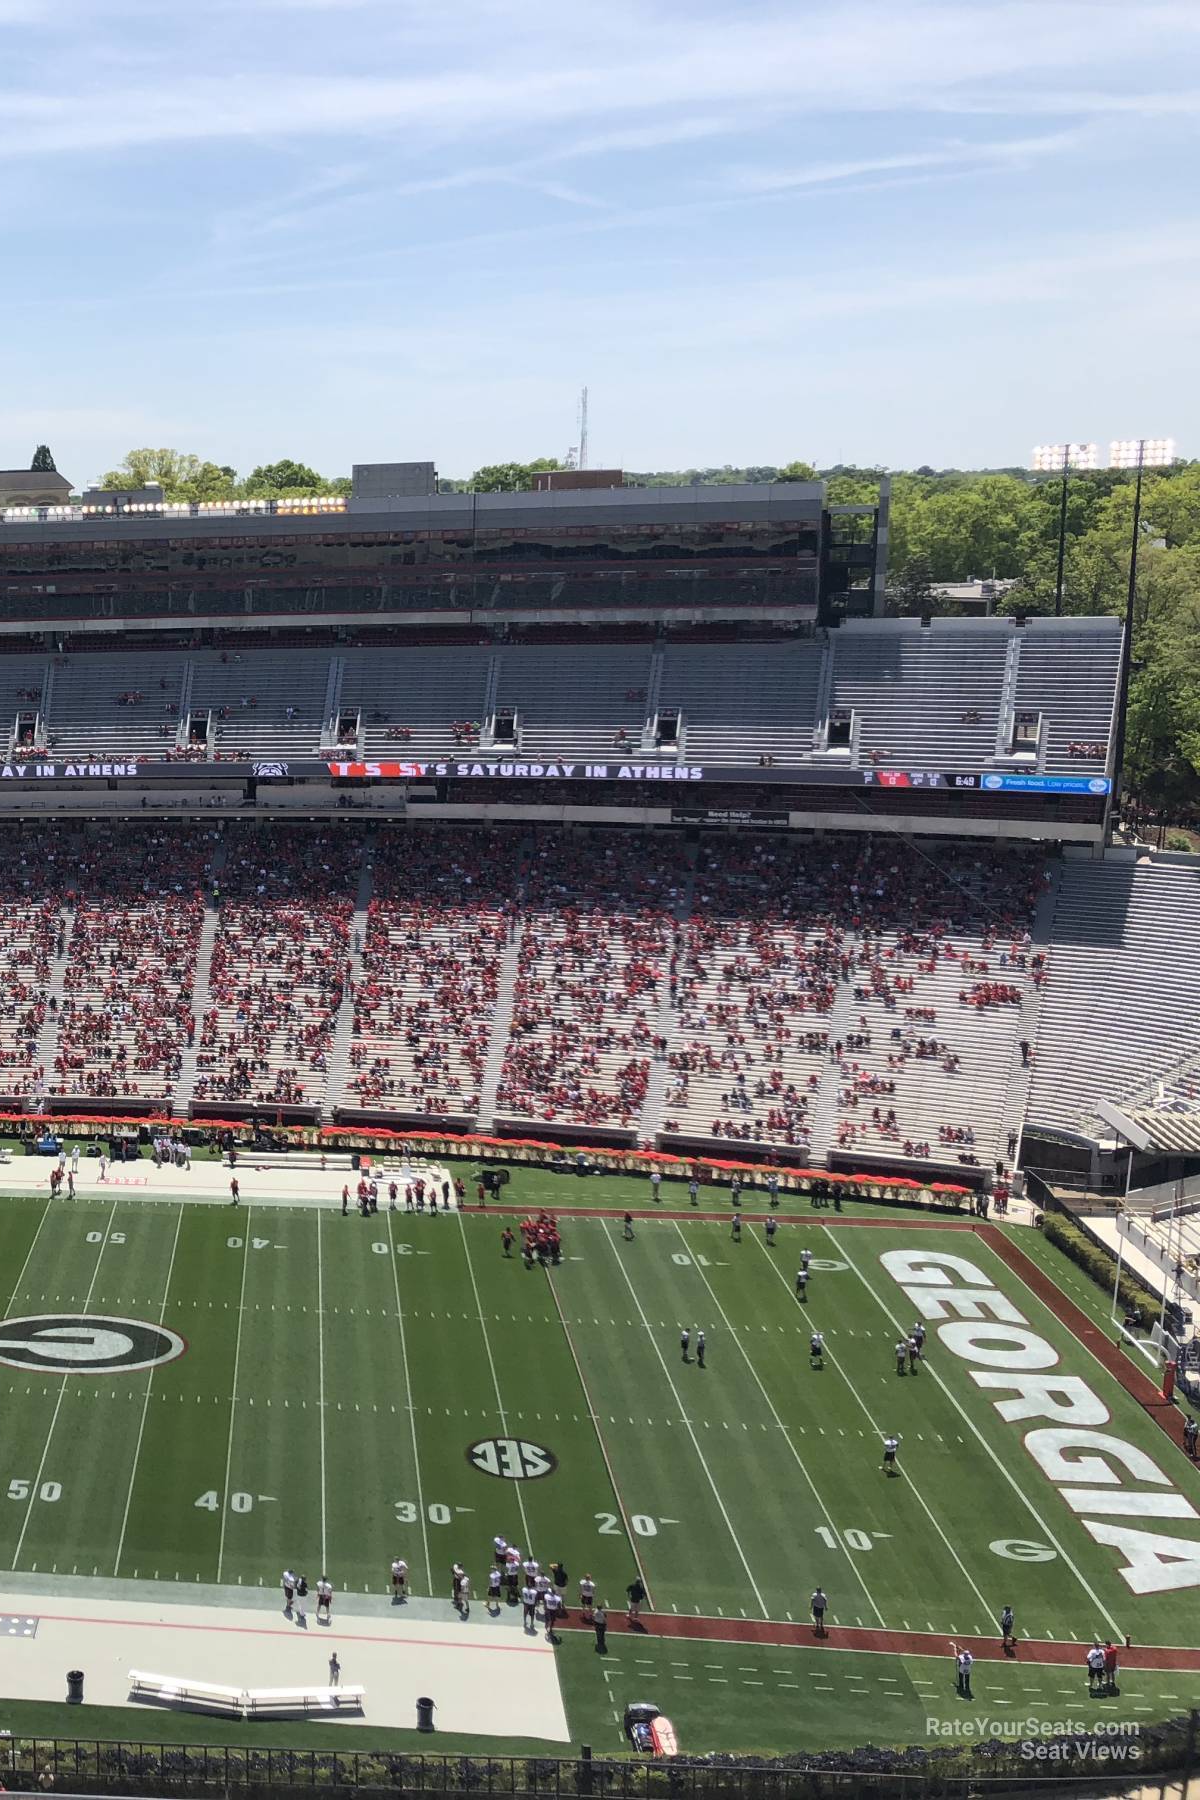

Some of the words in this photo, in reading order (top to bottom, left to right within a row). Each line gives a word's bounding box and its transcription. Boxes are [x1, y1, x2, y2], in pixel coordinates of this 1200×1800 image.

[36, 765, 55, 777] IN
[65, 764, 138, 776] ATHENS
[457, 764, 574, 777] SATURDAY
[586, 765, 607, 778] IN
[618, 766, 703, 780] ATHENS
[955, 776, 975, 786] 6:49
[86, 1231, 127, 1244] 50
[227, 1236, 270, 1249] 40
[371, 1242, 413, 1255] 30
[671, 1253, 712, 1266] 10
[879, 1250, 1200, 1595] GEORGIA
[471, 1439, 552, 1478] SEC
[6, 1479, 62, 1502] 50
[195, 1490, 254, 1513] 40
[394, 1501, 452, 1525] 30
[597, 1512, 660, 1537] 20
[814, 1526, 873, 1551] 10
